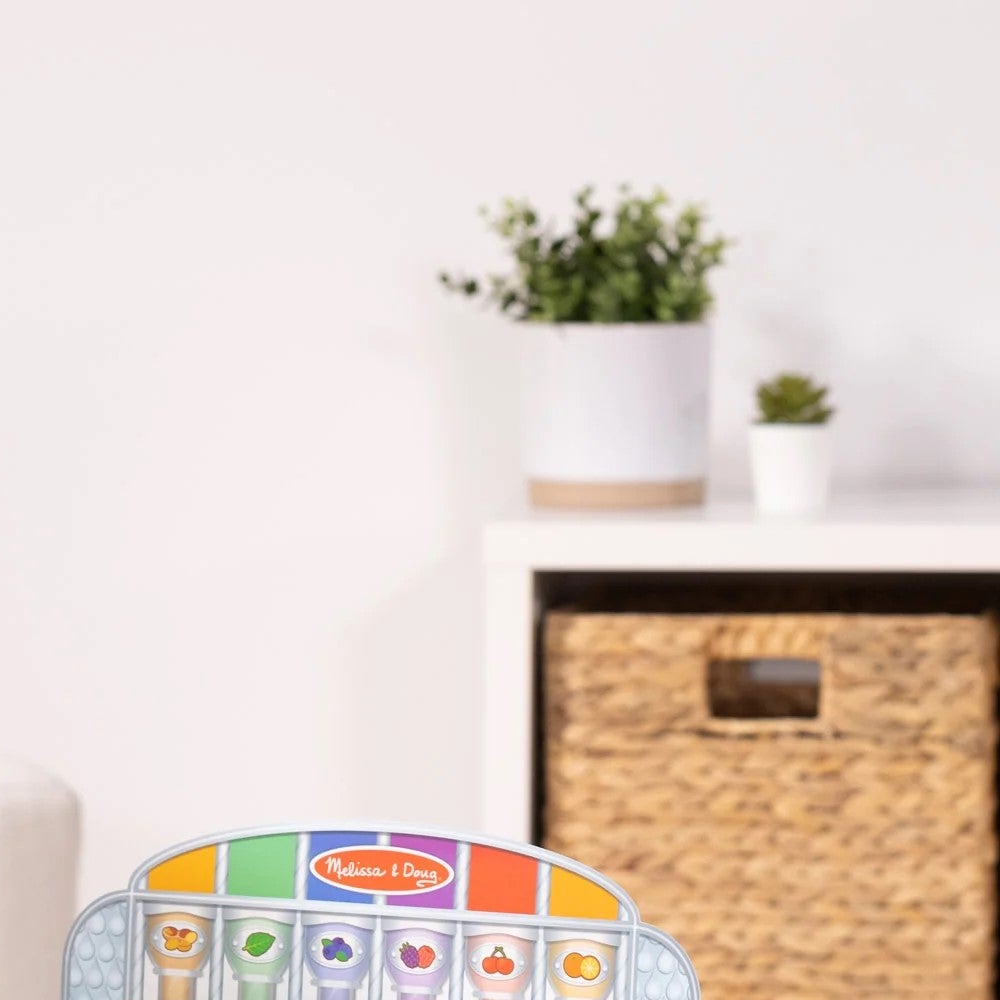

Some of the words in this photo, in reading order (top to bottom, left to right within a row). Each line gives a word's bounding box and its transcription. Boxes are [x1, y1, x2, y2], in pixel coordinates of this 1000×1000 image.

[325, 856, 387, 880] Melissa
[392, 863, 400, 877] &
[403, 862, 438, 887] Doug
